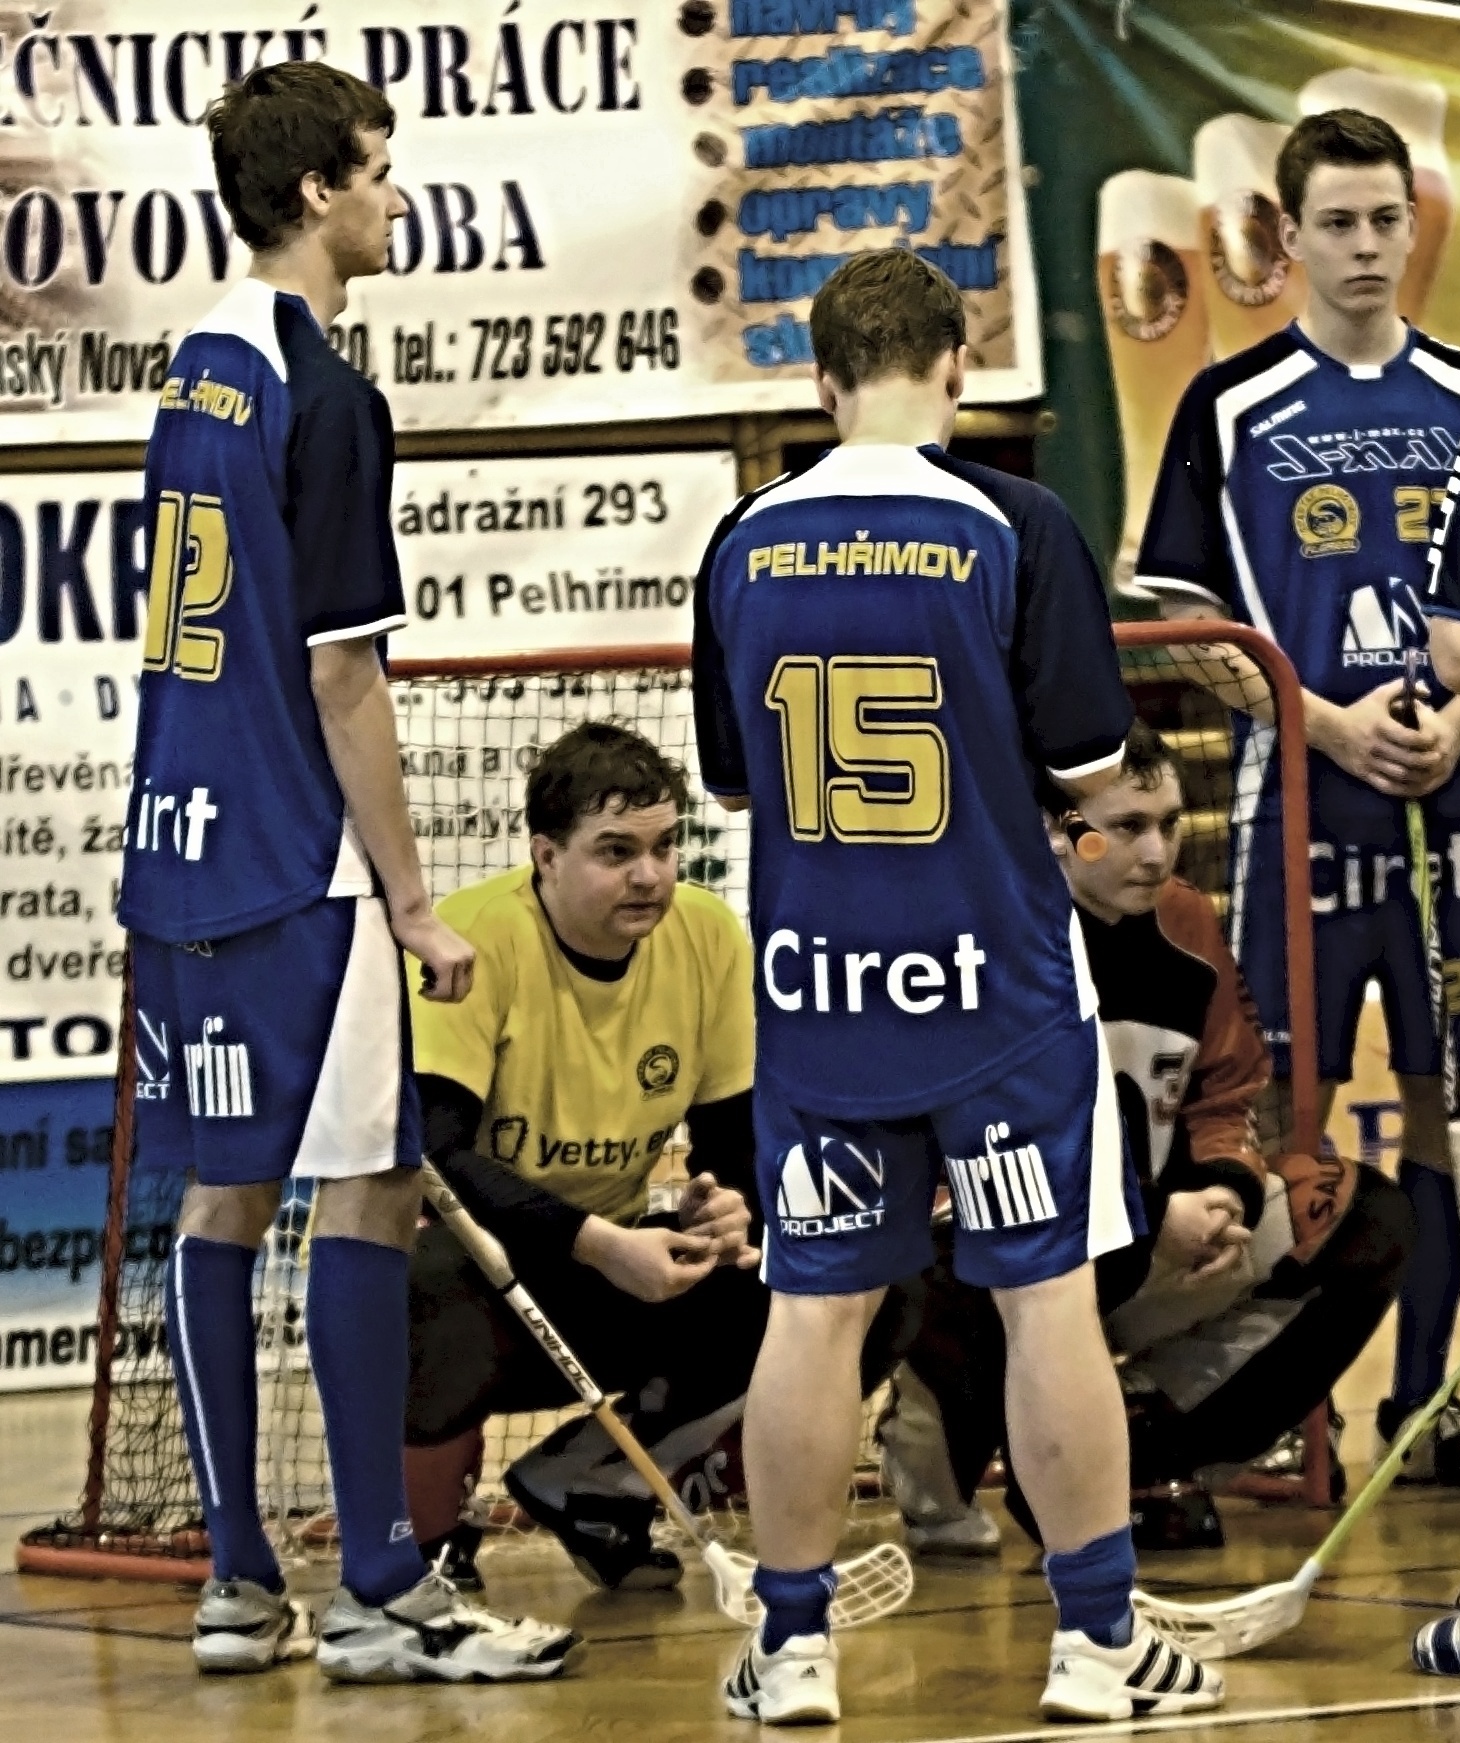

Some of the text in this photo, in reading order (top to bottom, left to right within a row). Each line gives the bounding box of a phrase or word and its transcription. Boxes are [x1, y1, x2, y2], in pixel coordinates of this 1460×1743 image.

[0, 2, 640, 128] ČNICK PRÁCE
[3, 180, 547, 287] OVOVOBA
[393, 318, 456, 384] tel.:
[471, 316, 532, 380] 723
[543, 312, 605, 374] 592
[615, 308, 680, 373] 646
[583, 481, 668, 526] 293
[142, 489, 236, 683] 12
[747, 529, 979, 584] PELHŘIMOV
[416, 574, 466, 622] 01
[1342, 651, 1430, 669] PROJT
[0, 752, 134, 793] řevěn
[763, 654, 952, 846] 15
[763, 929, 986, 1014] Ciret
[945, 1121, 1058, 1231] urfin
[780, 1208, 885, 1236] PROJECT
[523, 1306, 597, 1394] UNIHOC
